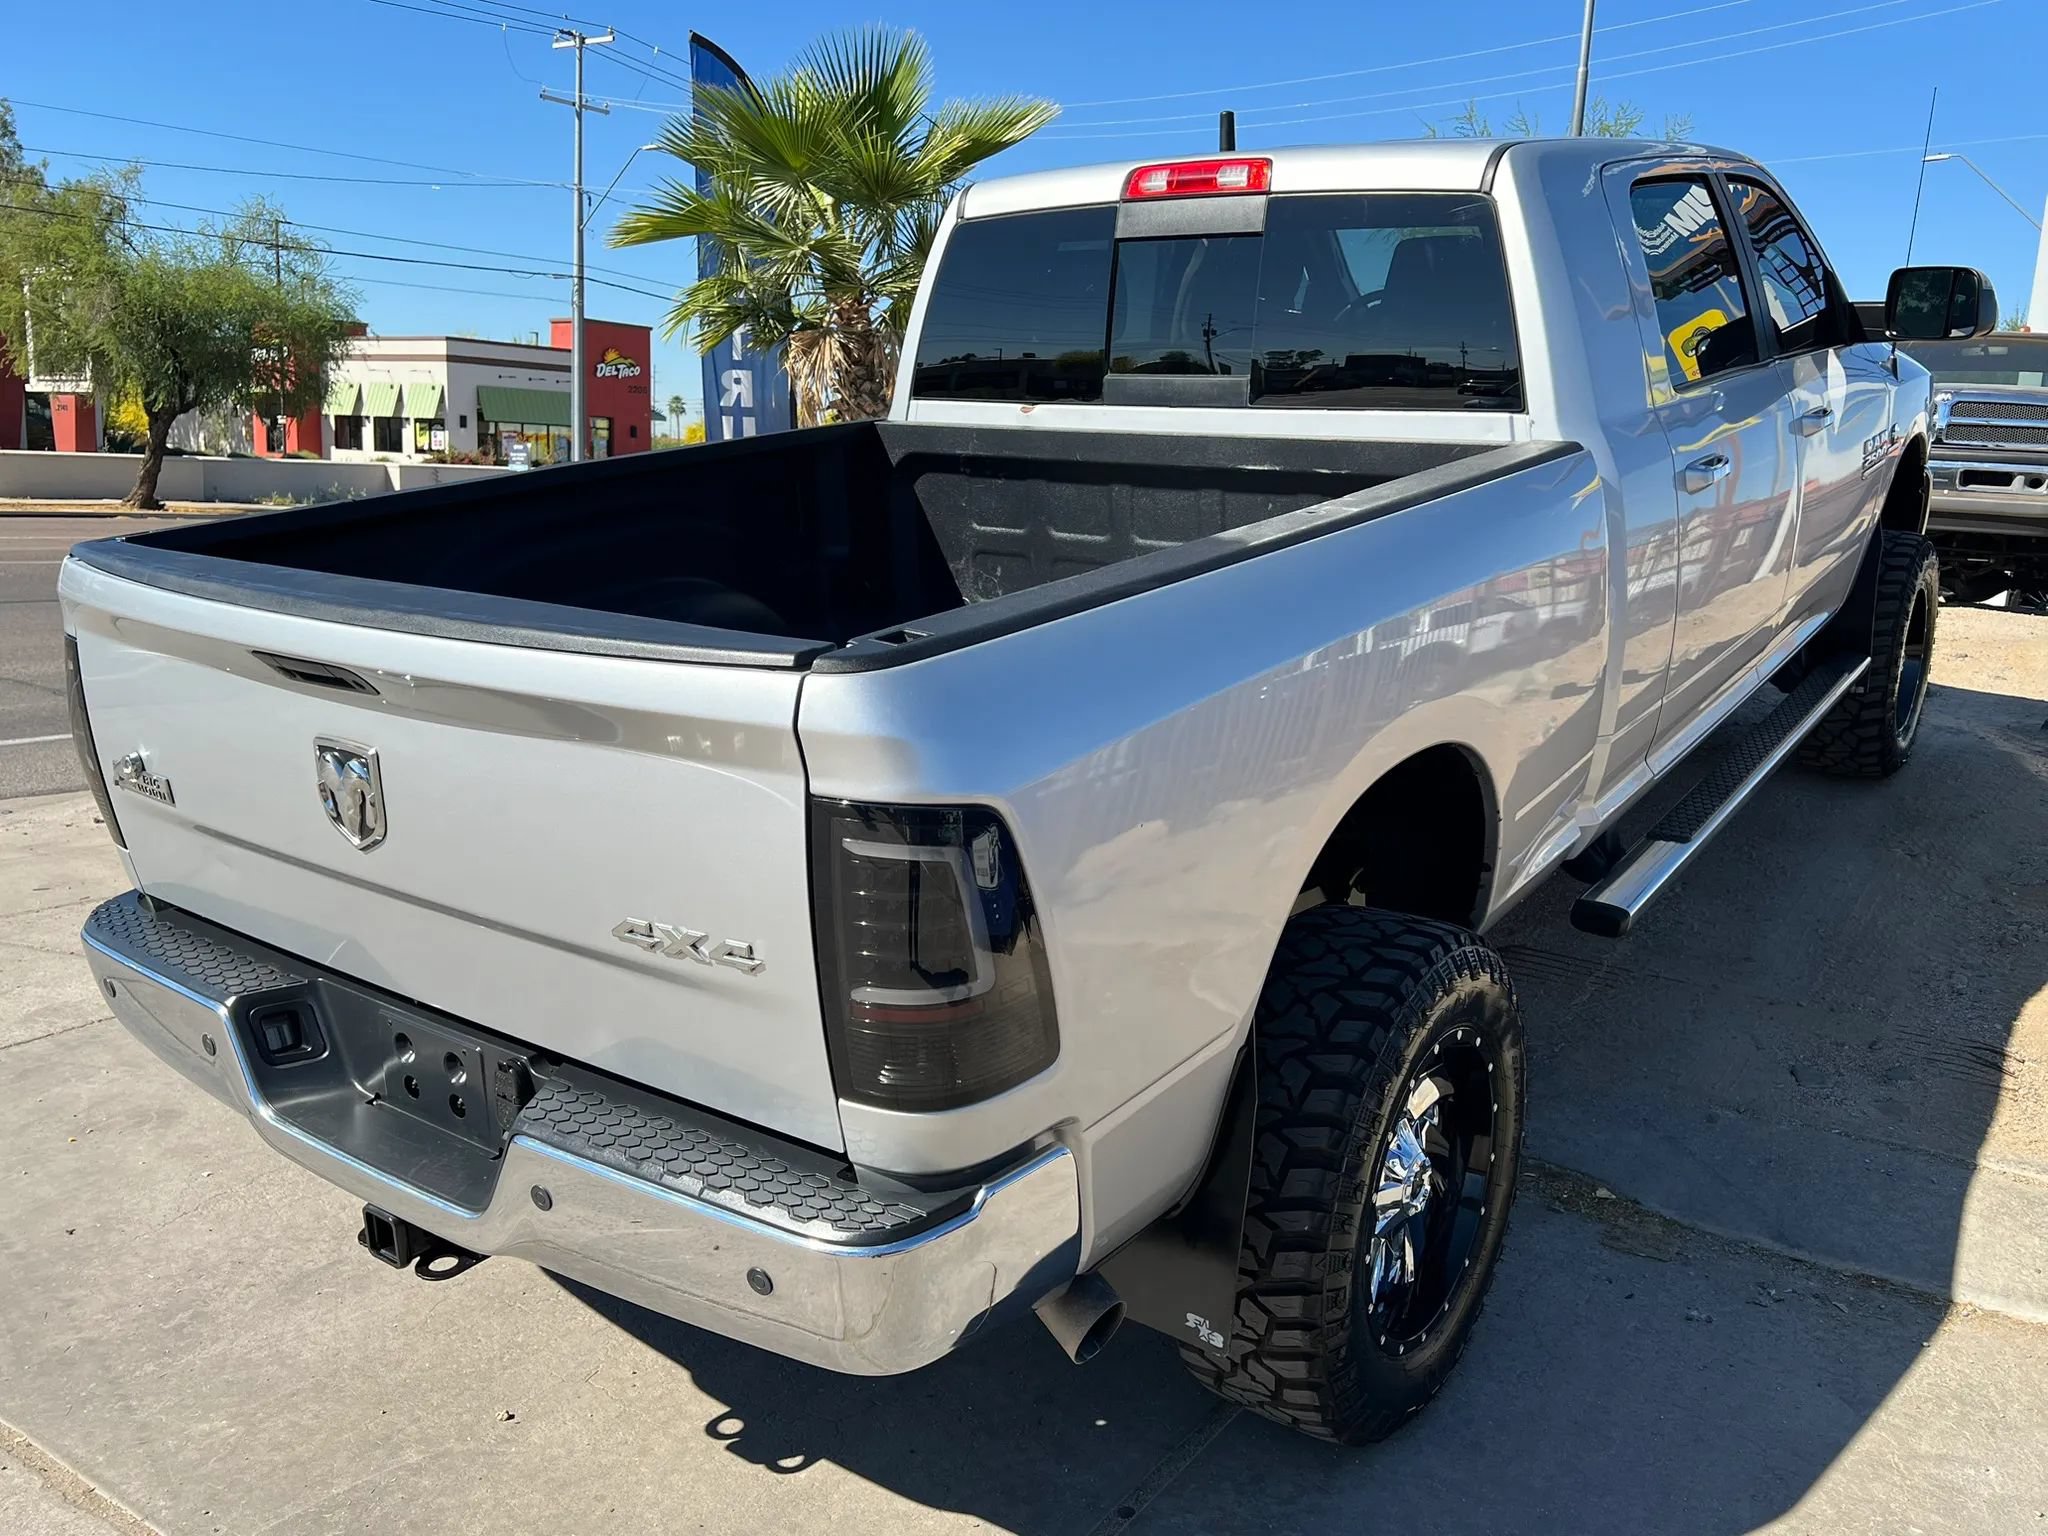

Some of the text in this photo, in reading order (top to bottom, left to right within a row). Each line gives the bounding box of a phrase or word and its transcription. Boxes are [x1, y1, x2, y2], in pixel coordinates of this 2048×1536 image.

[596, 363, 641, 379] DEL TACO
[142, 774, 161, 789] BIG
[137, 783, 167, 801] HORN
